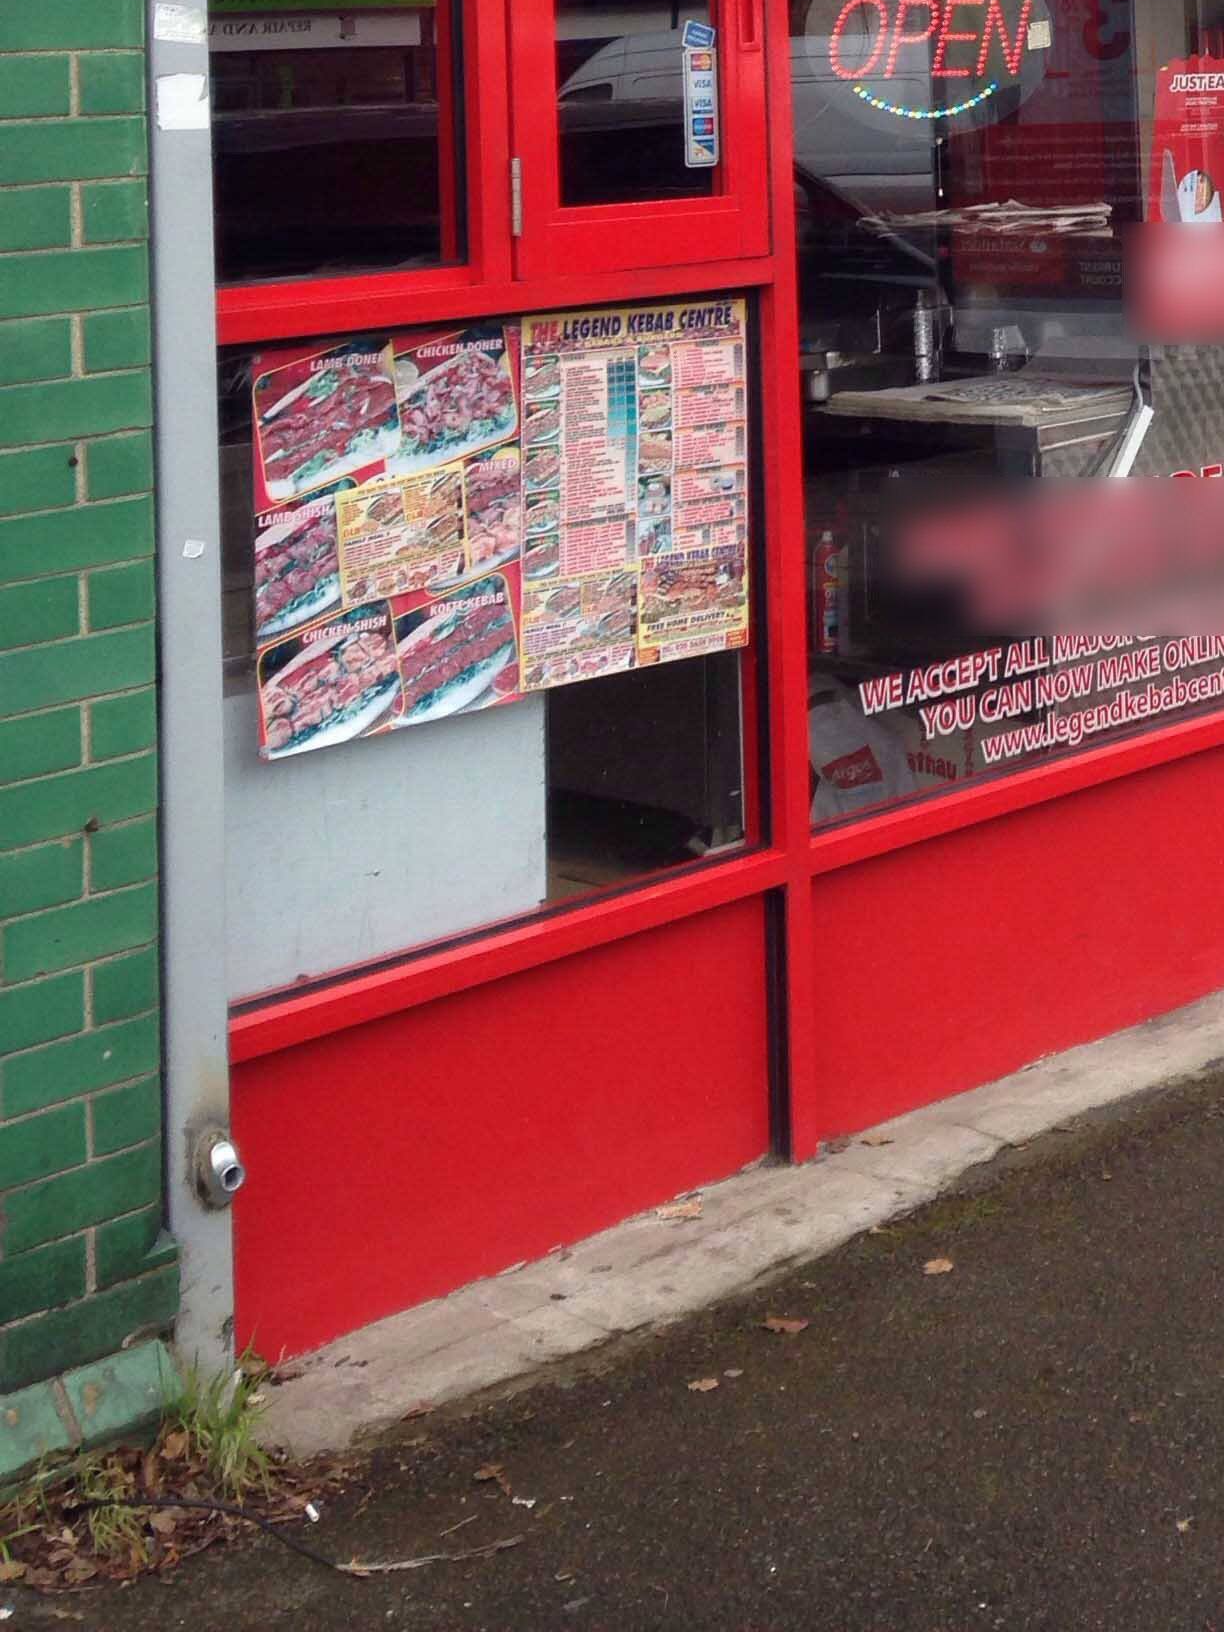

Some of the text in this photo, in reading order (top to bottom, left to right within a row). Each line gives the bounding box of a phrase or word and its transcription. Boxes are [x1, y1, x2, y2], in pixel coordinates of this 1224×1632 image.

[1170, 74, 1206, 92] JUST
[563, 315, 622, 340] LEGEND
[626, 311, 675, 334] KEBAB
[678, 305, 732, 329] CENTRE
[416, 338, 504, 359] CHICKEN DONER
[466, 591, 505, 609] KEBAB
[302, 615, 387, 644] CHICKEN SHISH
[858, 672, 904, 716] WE
[905, 647, 1003, 705] ACCEPT
[1004, 637, 1050, 678] ALL
[919, 694, 977, 741] YOU
[979, 680, 1033, 724] CAN
[1035, 663, 1095, 709] NOW
[1096, 644, 1161, 692] MAKE
